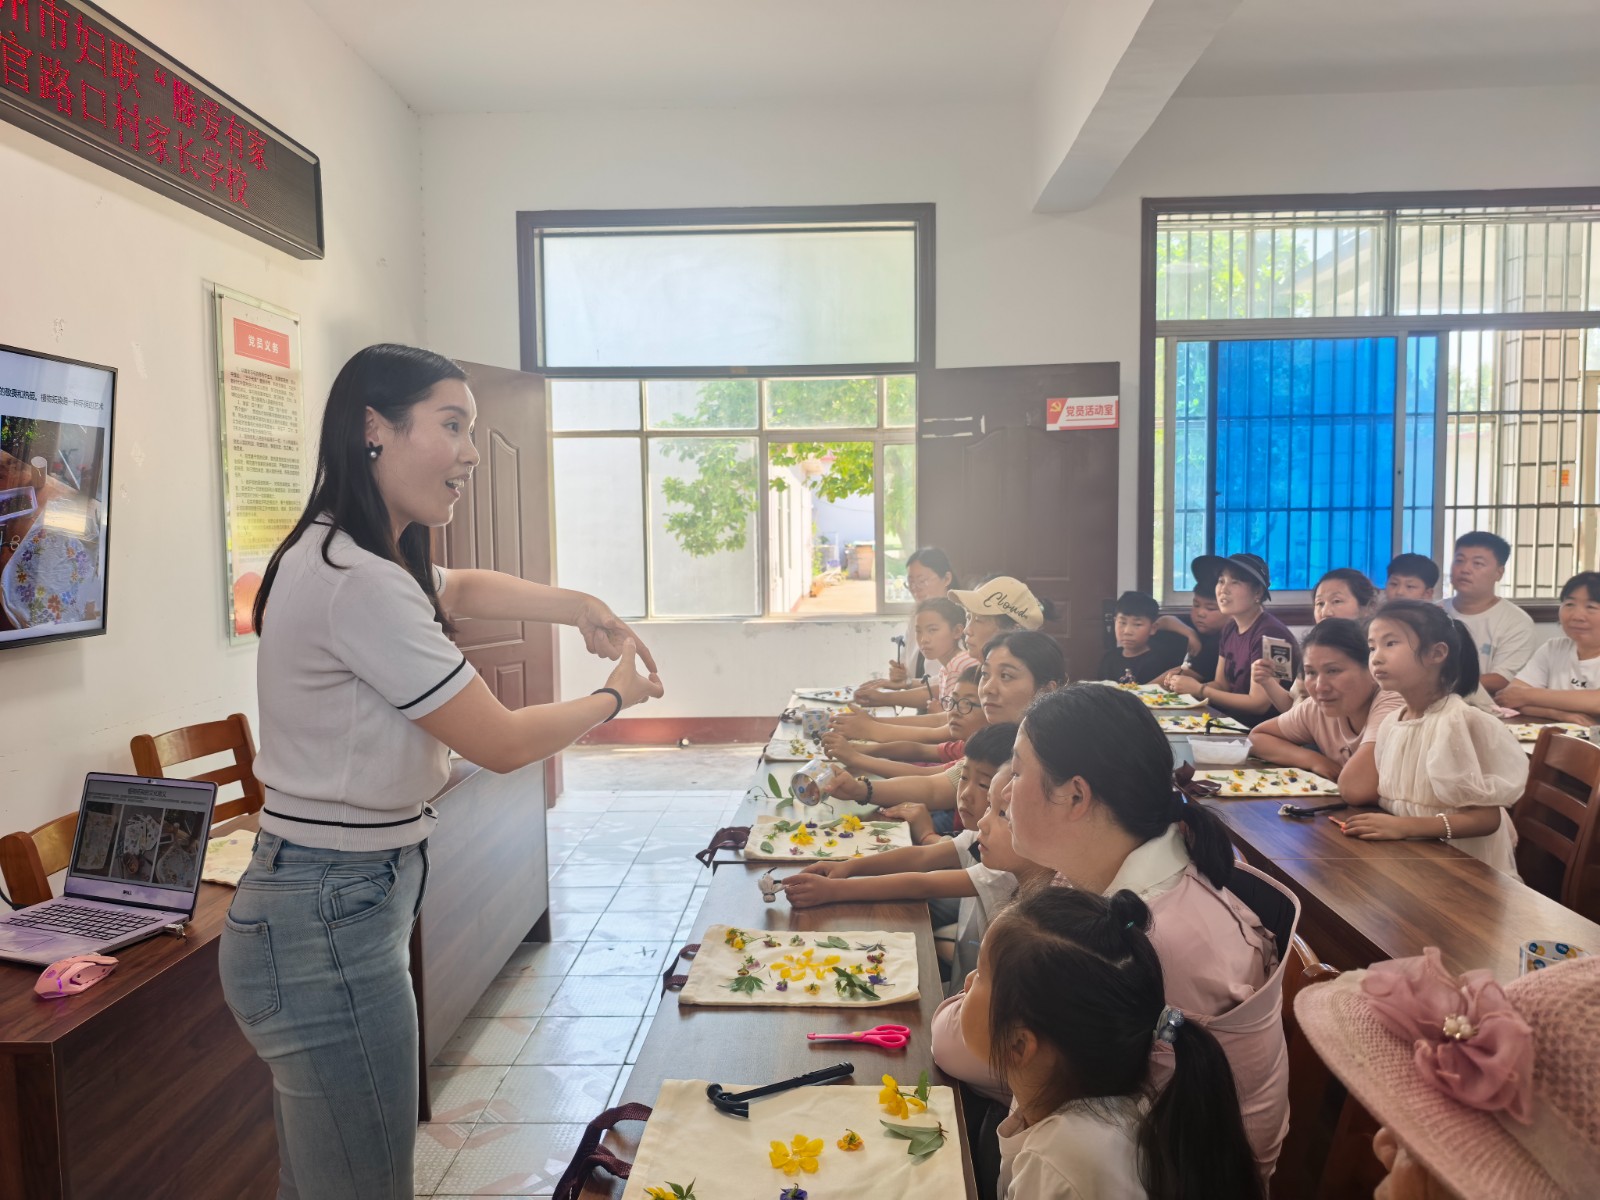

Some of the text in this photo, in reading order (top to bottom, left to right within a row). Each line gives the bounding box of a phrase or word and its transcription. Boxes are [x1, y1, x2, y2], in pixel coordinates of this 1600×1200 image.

[0, 31, 249, 208] 官路口村家长学校
[248, 334, 279, 354] 党员义务
[1066, 404, 1113, 417] 党员活动室
